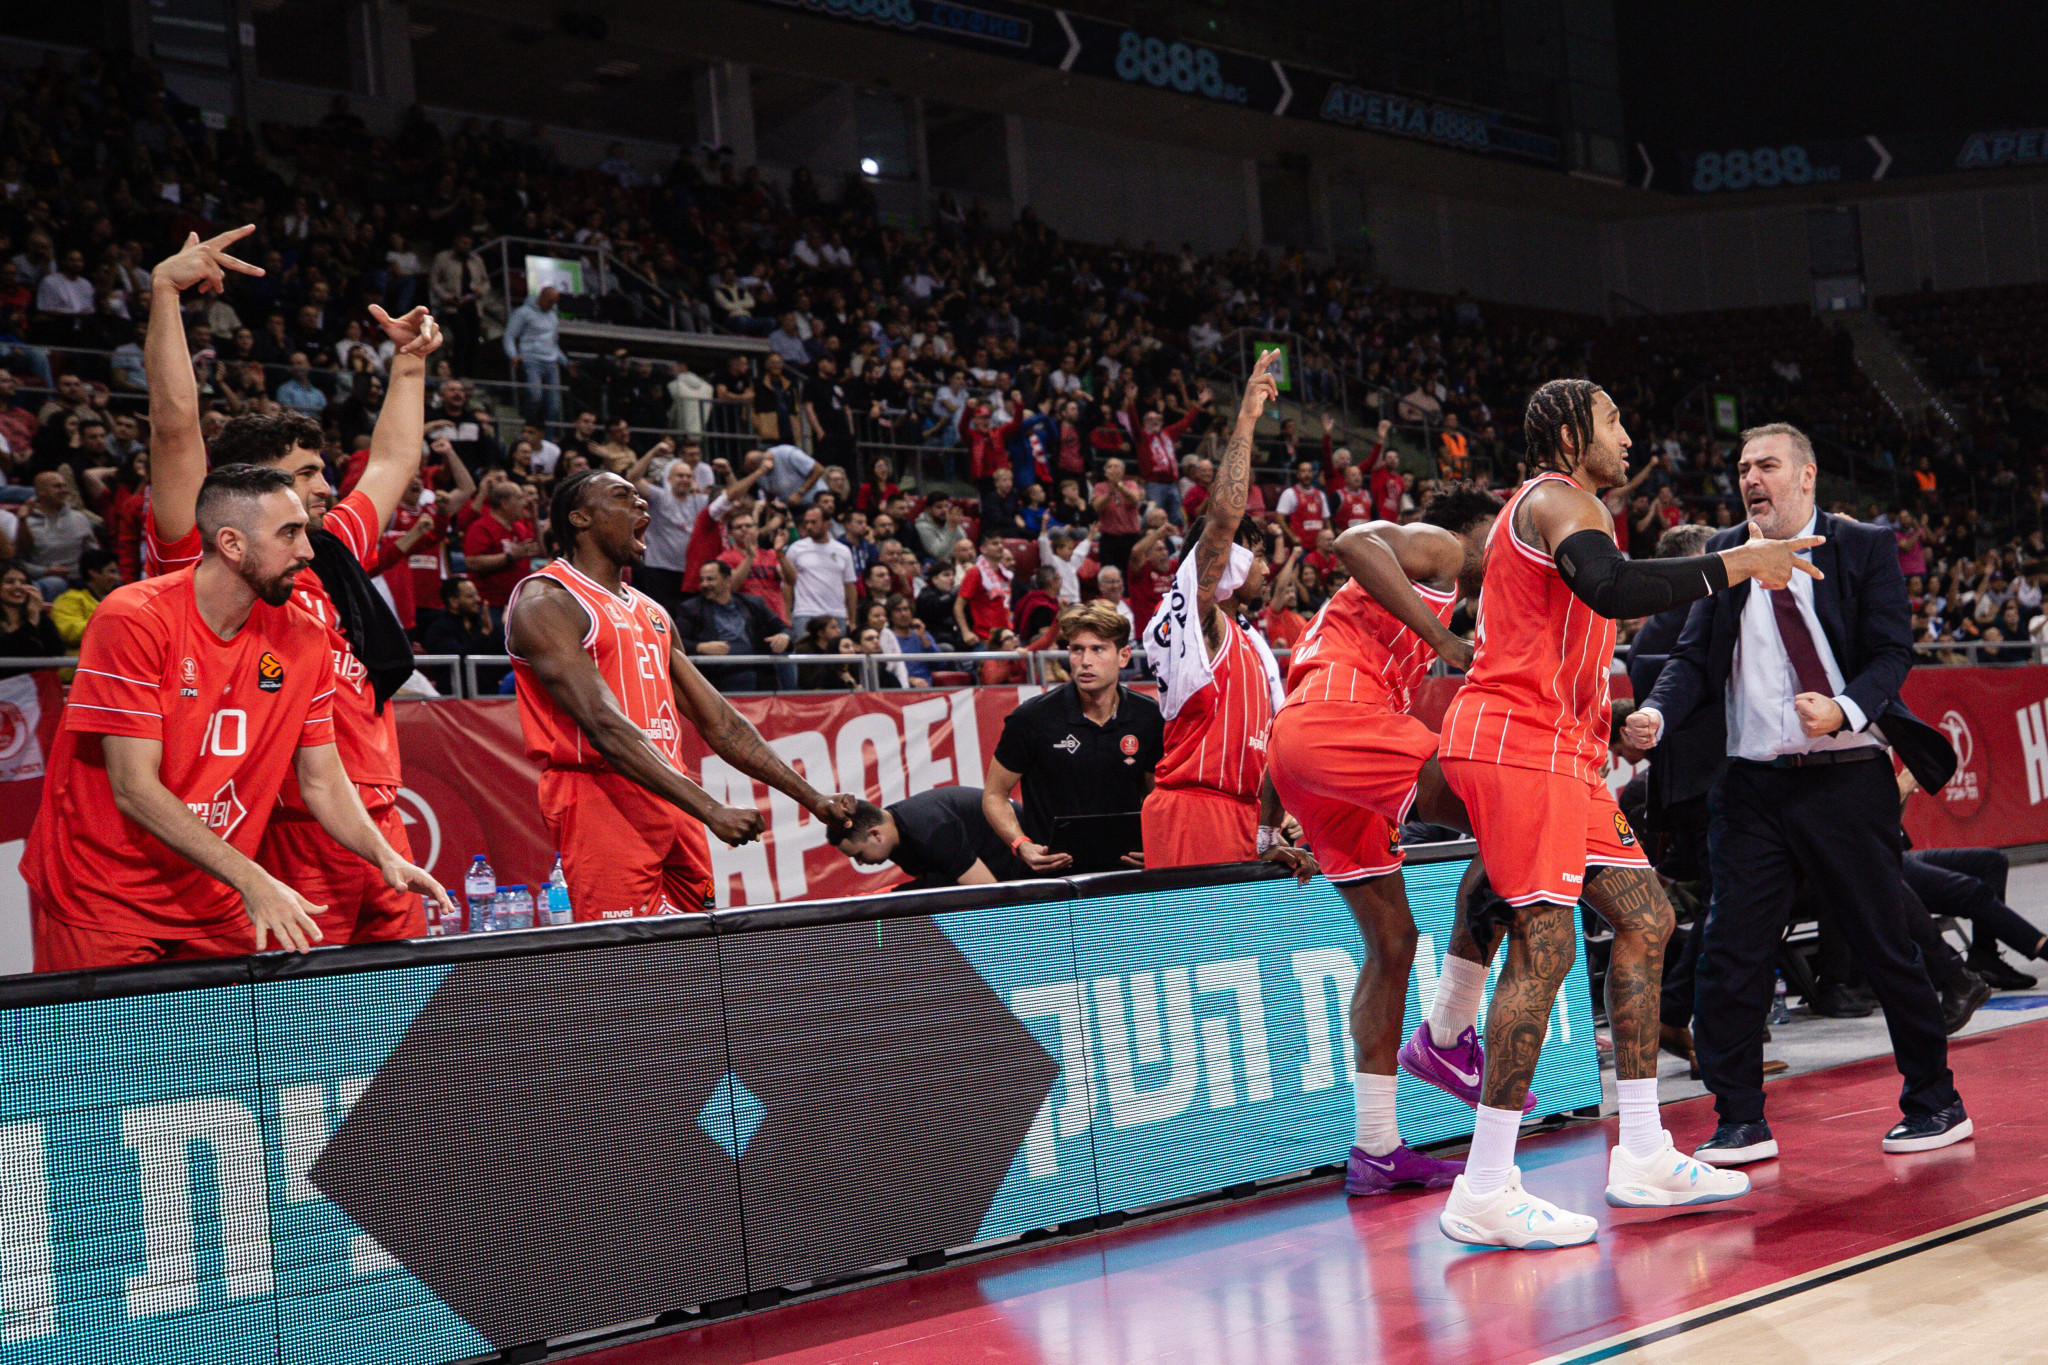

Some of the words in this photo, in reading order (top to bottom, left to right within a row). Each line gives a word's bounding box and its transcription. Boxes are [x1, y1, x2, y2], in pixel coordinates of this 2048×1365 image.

[1964, 130, 2048, 164] АРЕ
[635, 641, 665, 680] 21
[200, 708, 247, 756] 10
[2016, 697, 2048, 806] H
[208, 800, 231, 828] IBI
[602, 907, 633, 918] nuvei
[1615, 882, 1650, 914] QUIT
